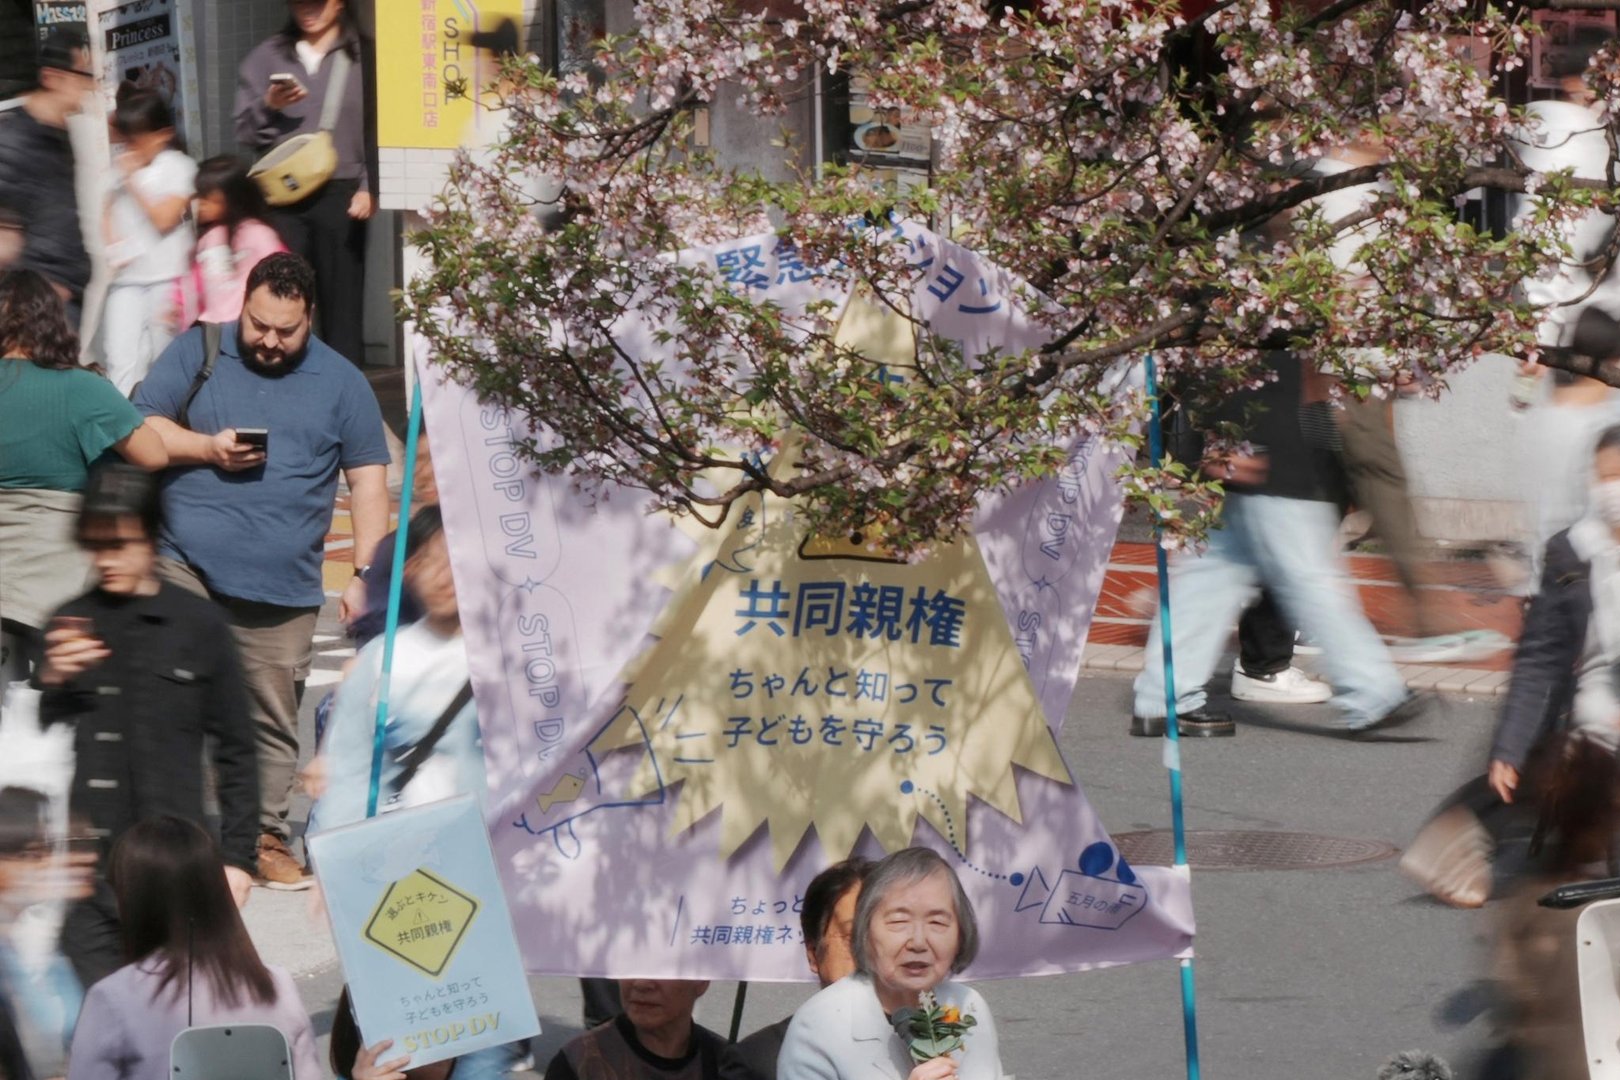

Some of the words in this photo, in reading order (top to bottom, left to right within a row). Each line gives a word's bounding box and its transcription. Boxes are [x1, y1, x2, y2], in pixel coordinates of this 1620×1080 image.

[111, 24, 164, 49] Princess
[498, 512, 538, 560] DV
[1039, 511, 1073, 561] DV
[733, 578, 967, 648] 共同親権
[517, 612, 562, 709] STOP
[728, 665, 954, 708] ちゃんと知って
[722, 713, 948, 756] 子どもを守ろう
[396, 920, 453, 946] 共同親権
[400, 976, 483, 1008] ちゃんと知って
[404, 992, 489, 1025] 子どもを守ろう
[403, 1022, 465, 1054] STOP
[467, 1010, 502, 1037] DV
